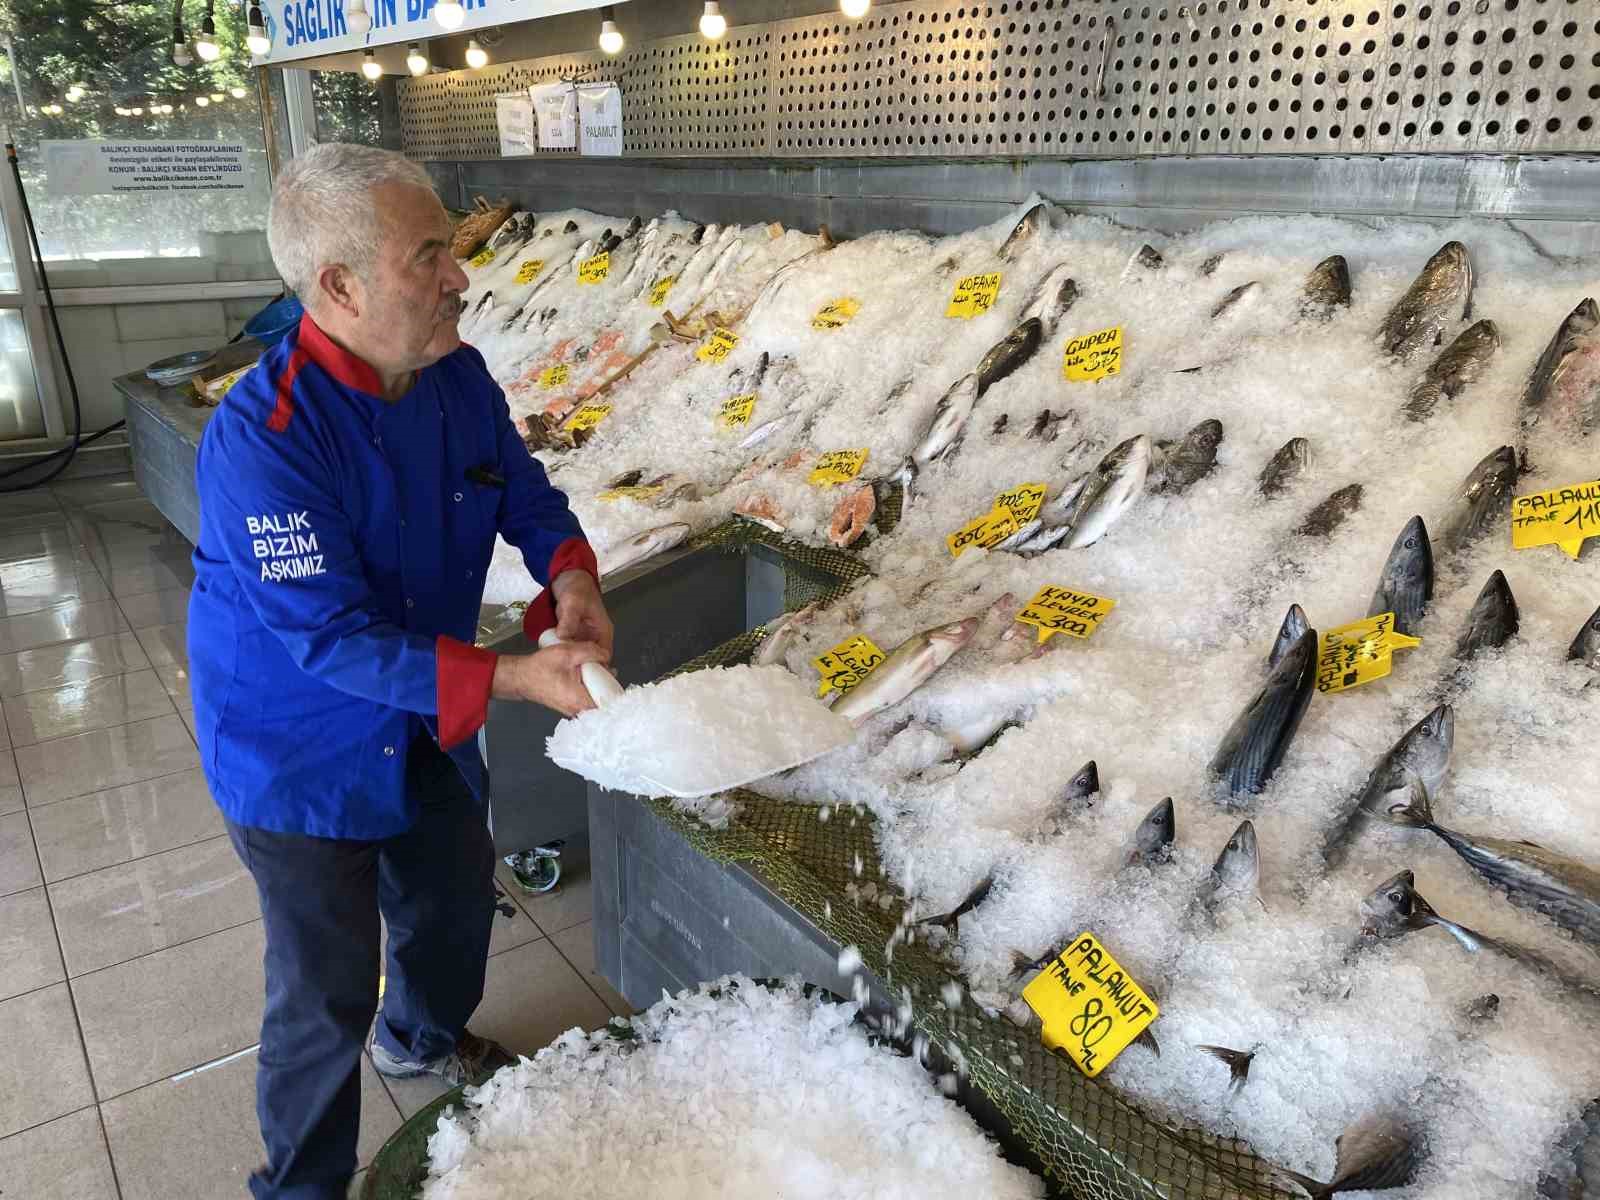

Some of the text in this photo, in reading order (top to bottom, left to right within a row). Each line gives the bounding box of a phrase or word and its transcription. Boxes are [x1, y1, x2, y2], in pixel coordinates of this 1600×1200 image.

[585, 126, 618, 137] PALAMUT
[959, 275, 998, 291] KOFANA
[246, 511, 311, 534] BALIK
[1513, 510, 1559, 529] TANE
[253, 533, 318, 558] BİZİM
[261, 555, 327, 583] AŞKIMIZ
[1032, 598, 1105, 623] LEVREK
[1041, 588, 1099, 608] KAYA
[1318, 632, 1344, 693] PALAMUT
[1049, 957, 1086, 997] TANE
[1067, 938, 1153, 1024] PALAMUT
[1070, 997, 1113, 1049] 80
